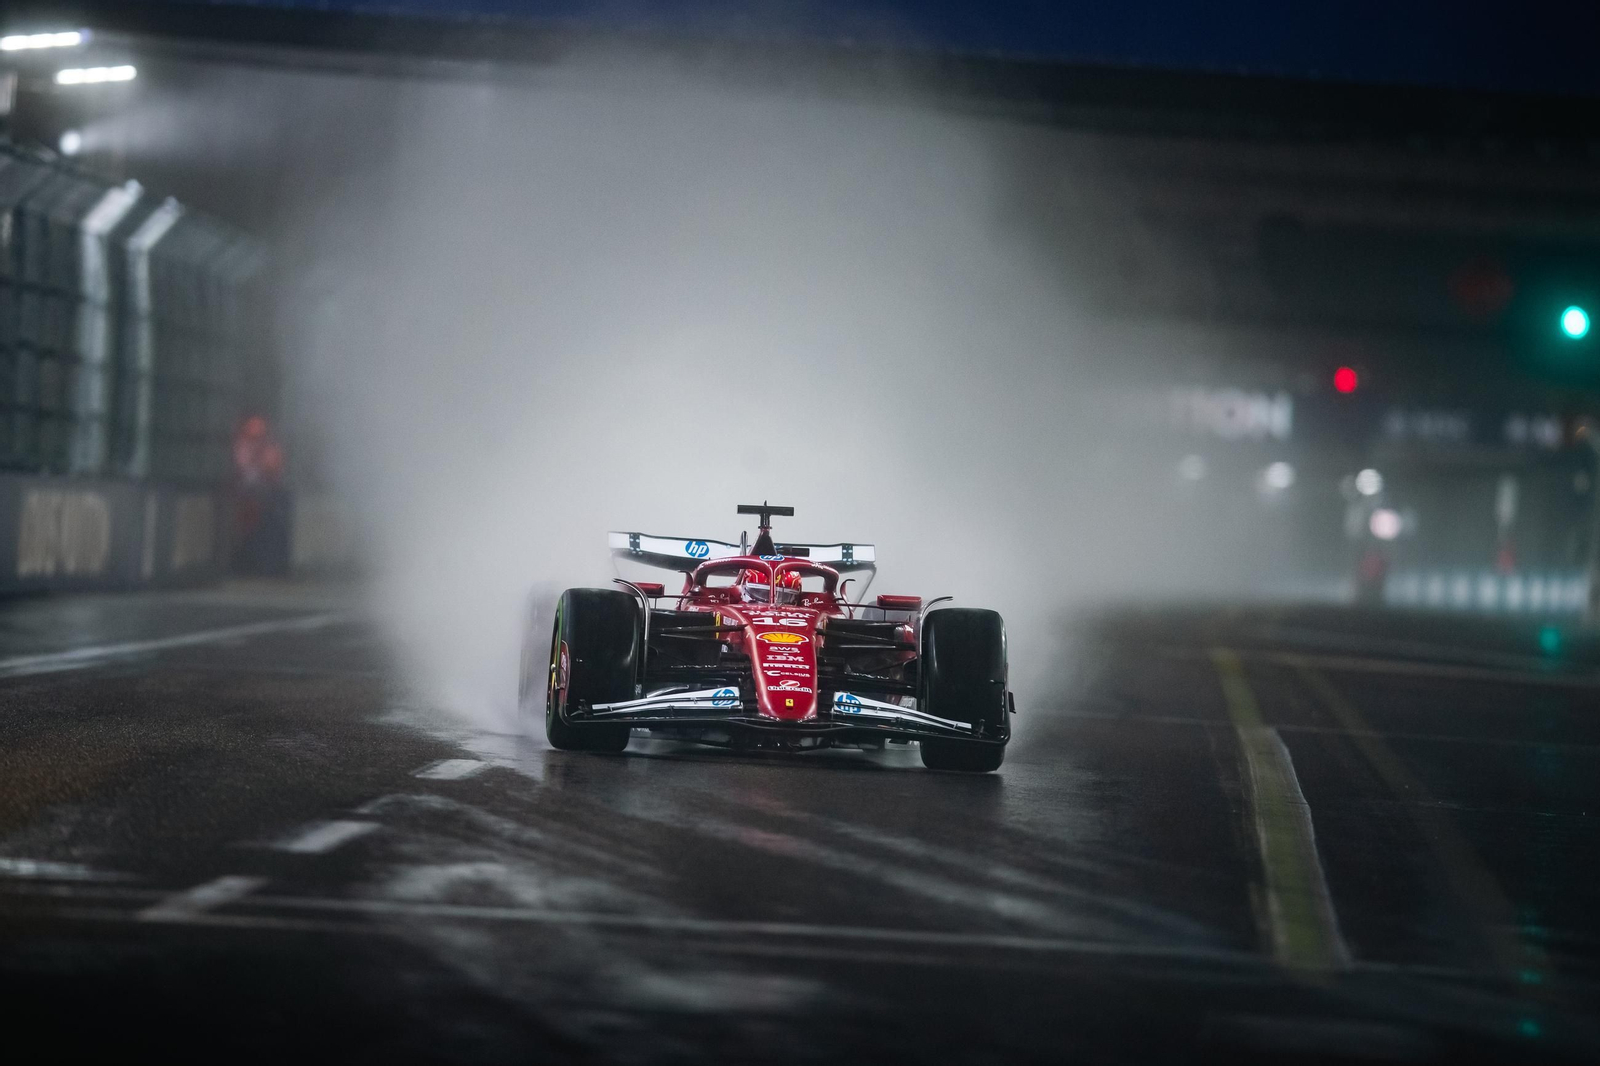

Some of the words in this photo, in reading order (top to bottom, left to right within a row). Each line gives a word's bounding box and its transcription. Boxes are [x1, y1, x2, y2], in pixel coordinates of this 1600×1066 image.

[687, 541, 708, 558] hp
[752, 617, 808, 627] 16
[713, 688, 734, 706] hp
[840, 694, 860, 713] hp
